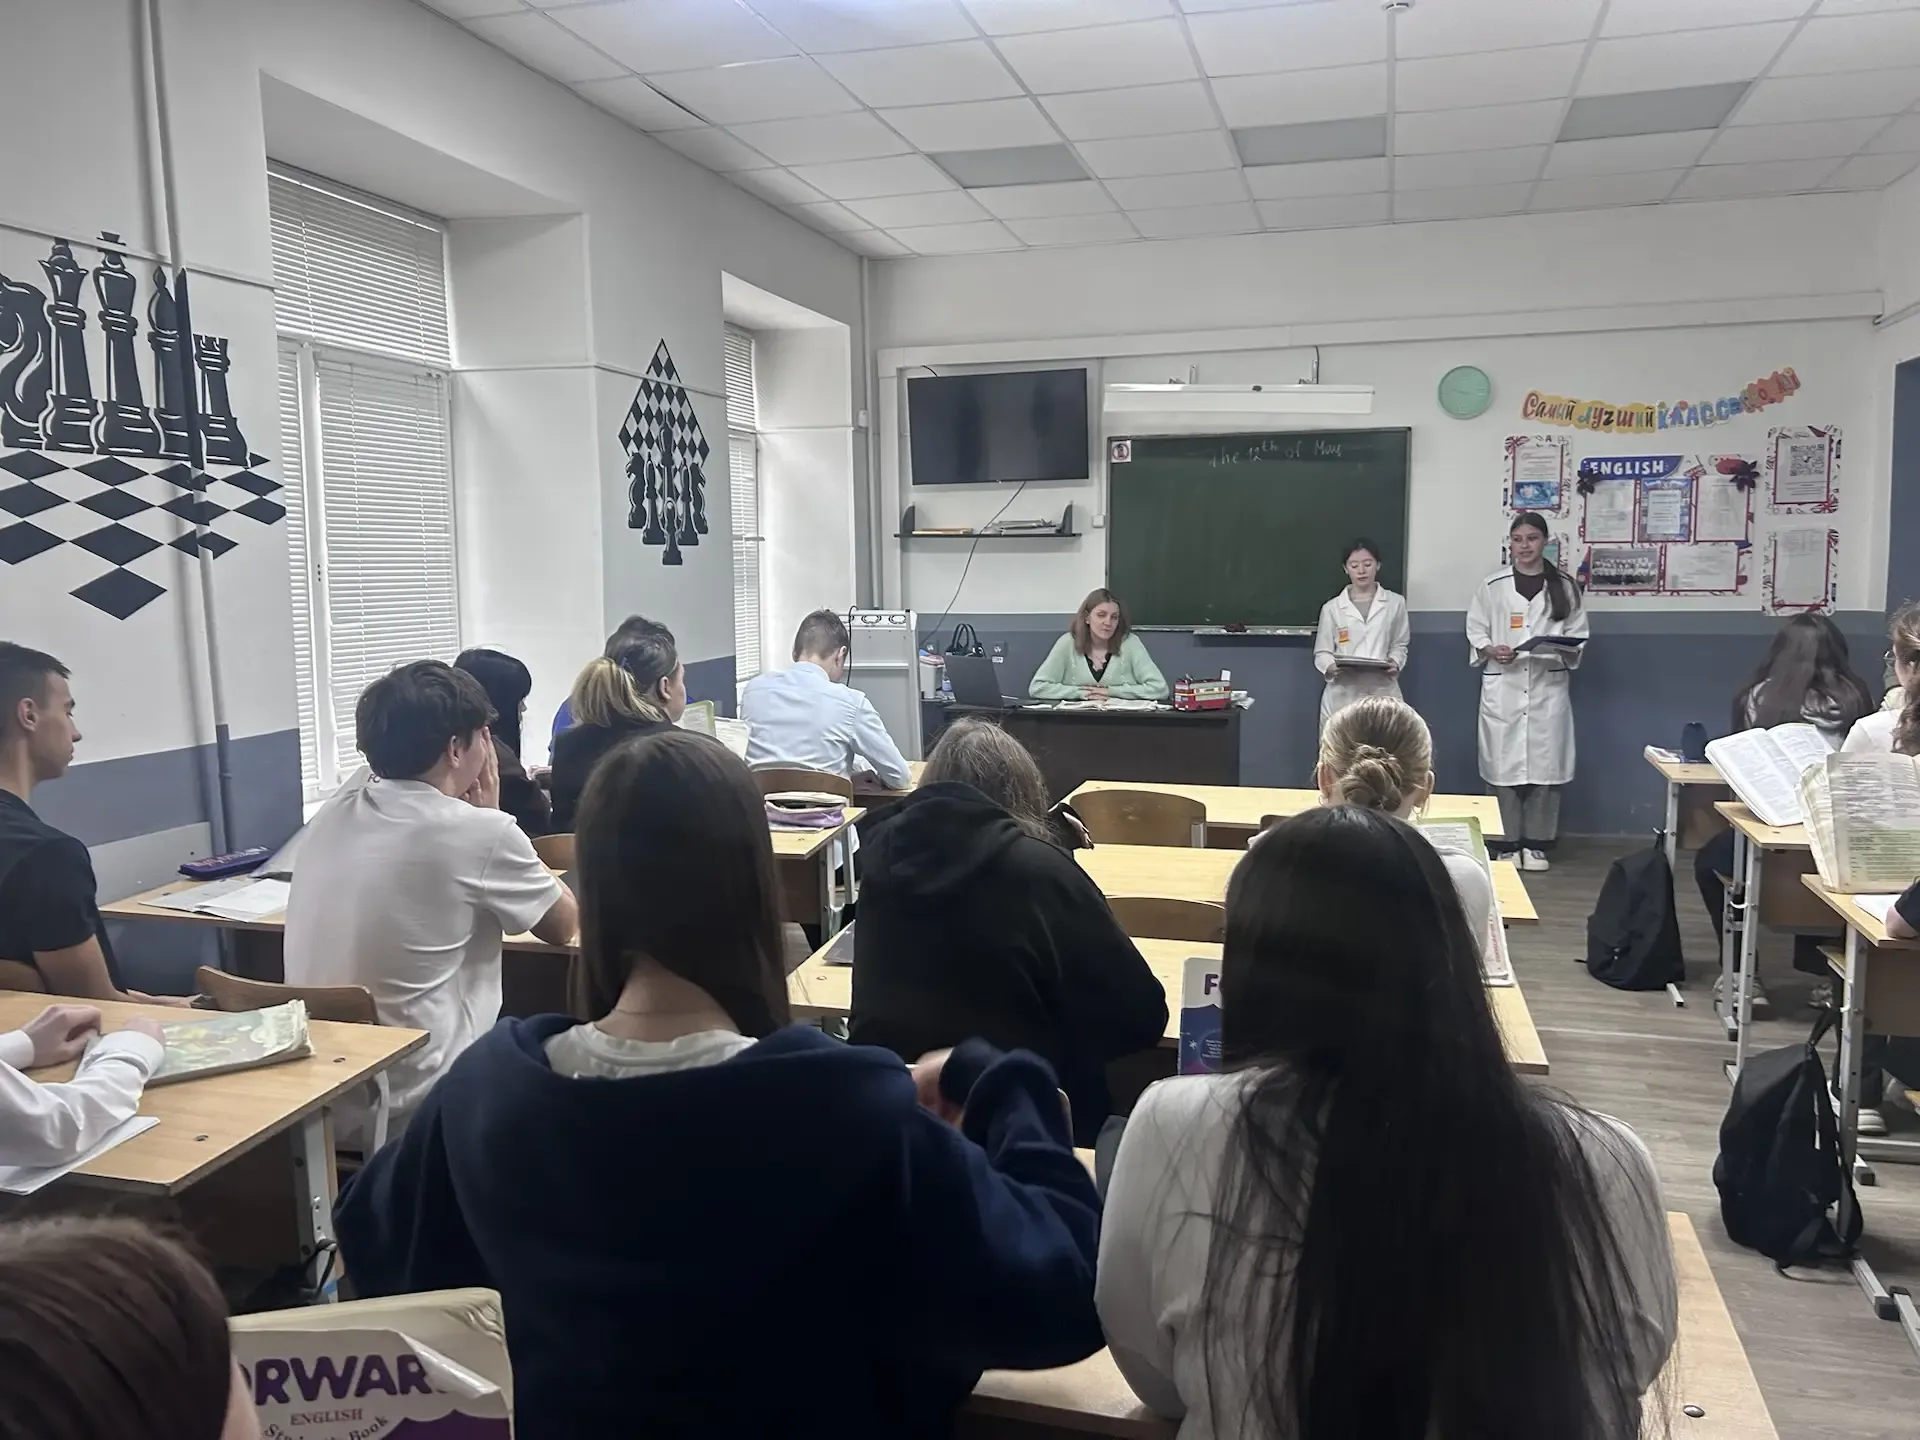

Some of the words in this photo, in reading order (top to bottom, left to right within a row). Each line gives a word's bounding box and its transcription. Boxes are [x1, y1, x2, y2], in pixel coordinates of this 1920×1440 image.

[1522, 391, 1575, 421] Самый
[1285, 440, 1303, 459] of
[1589, 460, 1665, 476] ENGLISH
[1204, 973, 1222, 996] F
[238, 1354, 450, 1406] RWAR
[289, 1407, 364, 1427] ENGLISH
[348, 1414, 389, 1440] Book
